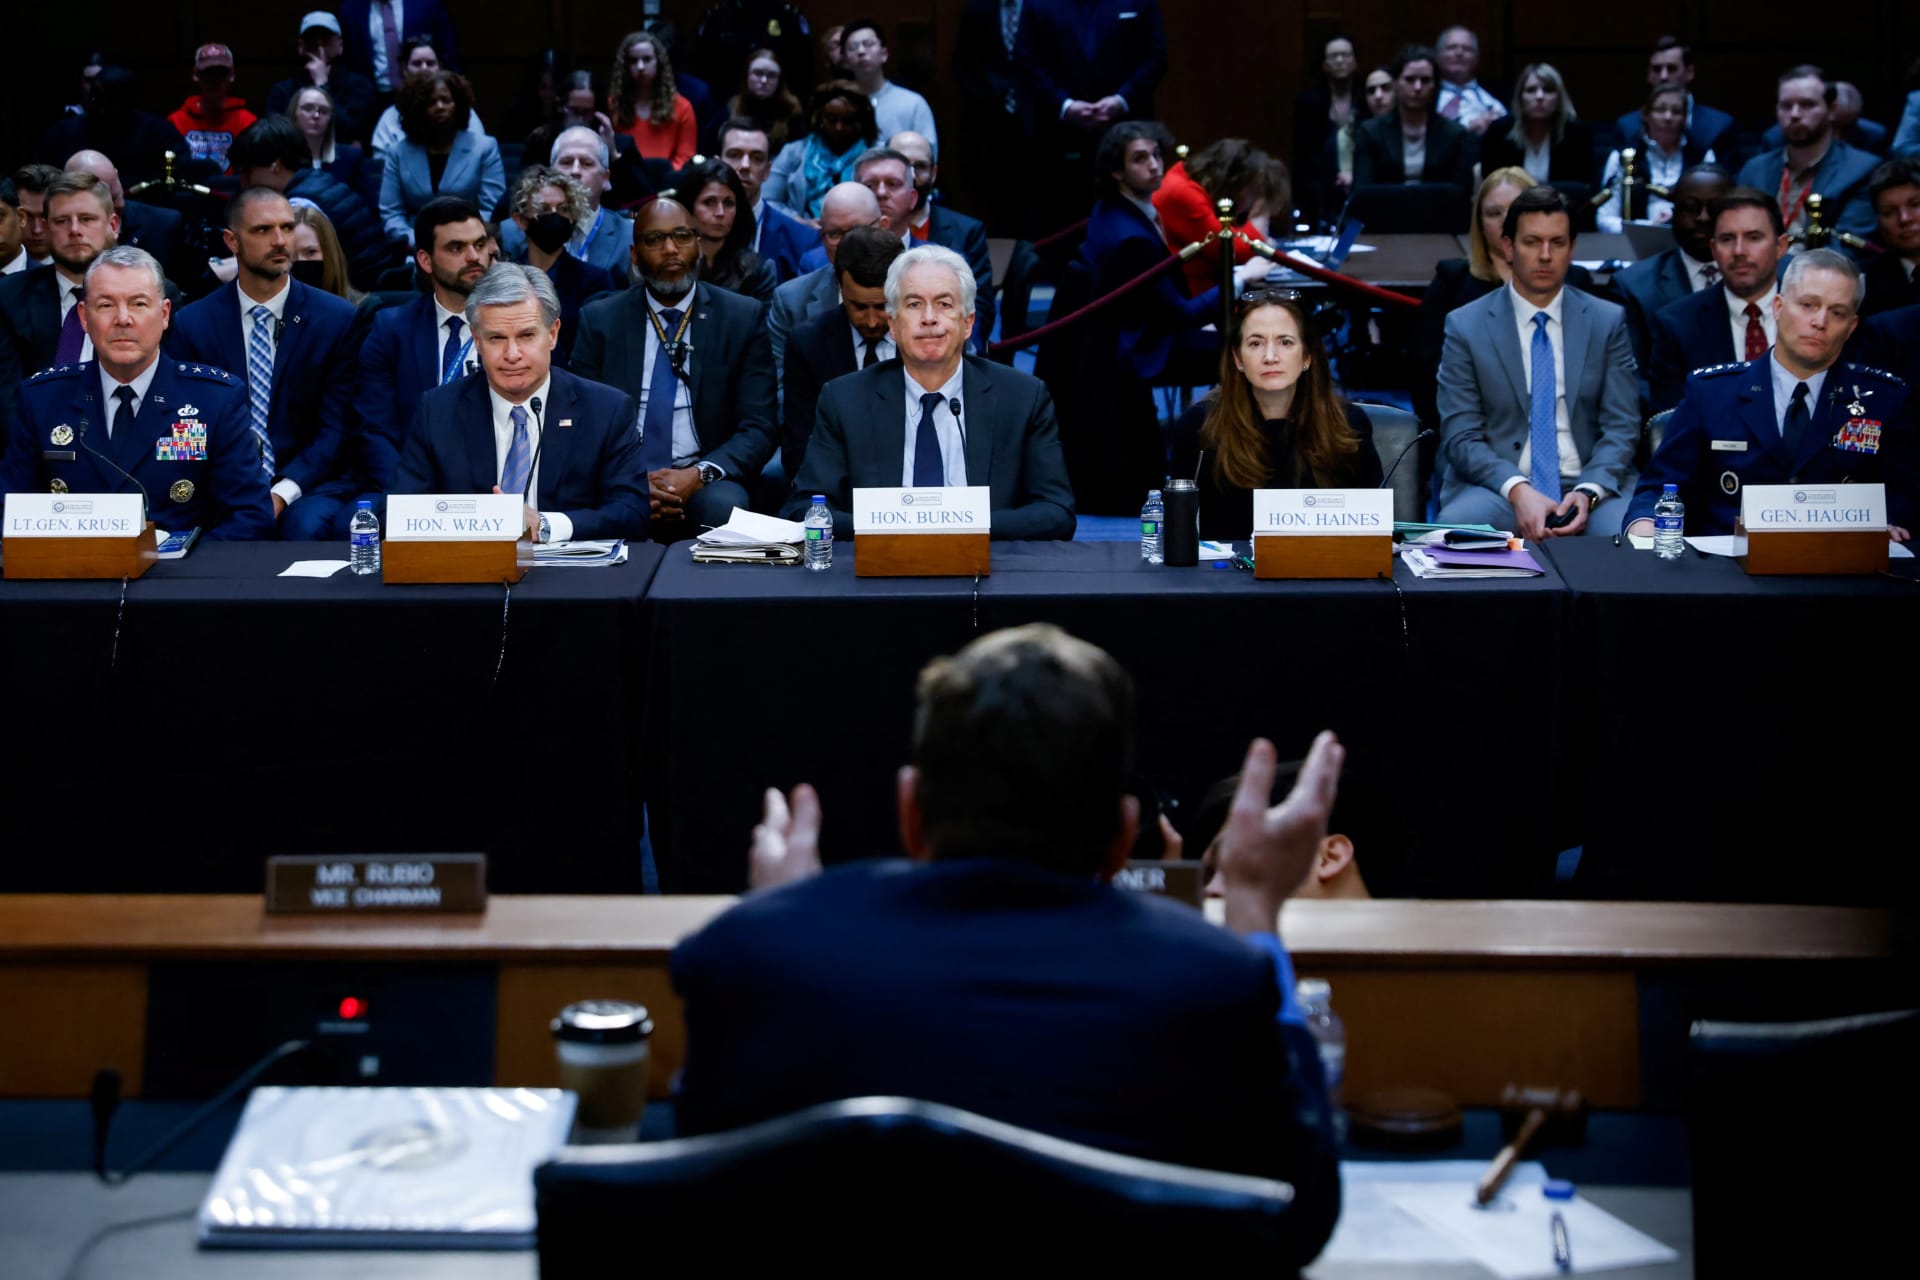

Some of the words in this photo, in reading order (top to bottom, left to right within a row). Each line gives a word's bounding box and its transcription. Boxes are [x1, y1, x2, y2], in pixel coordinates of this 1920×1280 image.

[871, 511, 912, 524] HON.
[917, 510, 974, 524] BURNS
[1269, 512, 1310, 526] HON.
[1316, 512, 1380, 526] HAINES
[1761, 508, 1801, 523] GEN.
[1807, 508, 1871, 523] HAUGH
[12, 518, 72, 532] LT.GEN.
[77, 518, 130, 531] KRUSE
[406, 518, 447, 532] HON.
[452, 518, 504, 531] WRAY
[317, 863, 358, 884] MR.
[366, 863, 434, 884] RUBIO
[354, 887, 441, 905] CHAIRMAN
